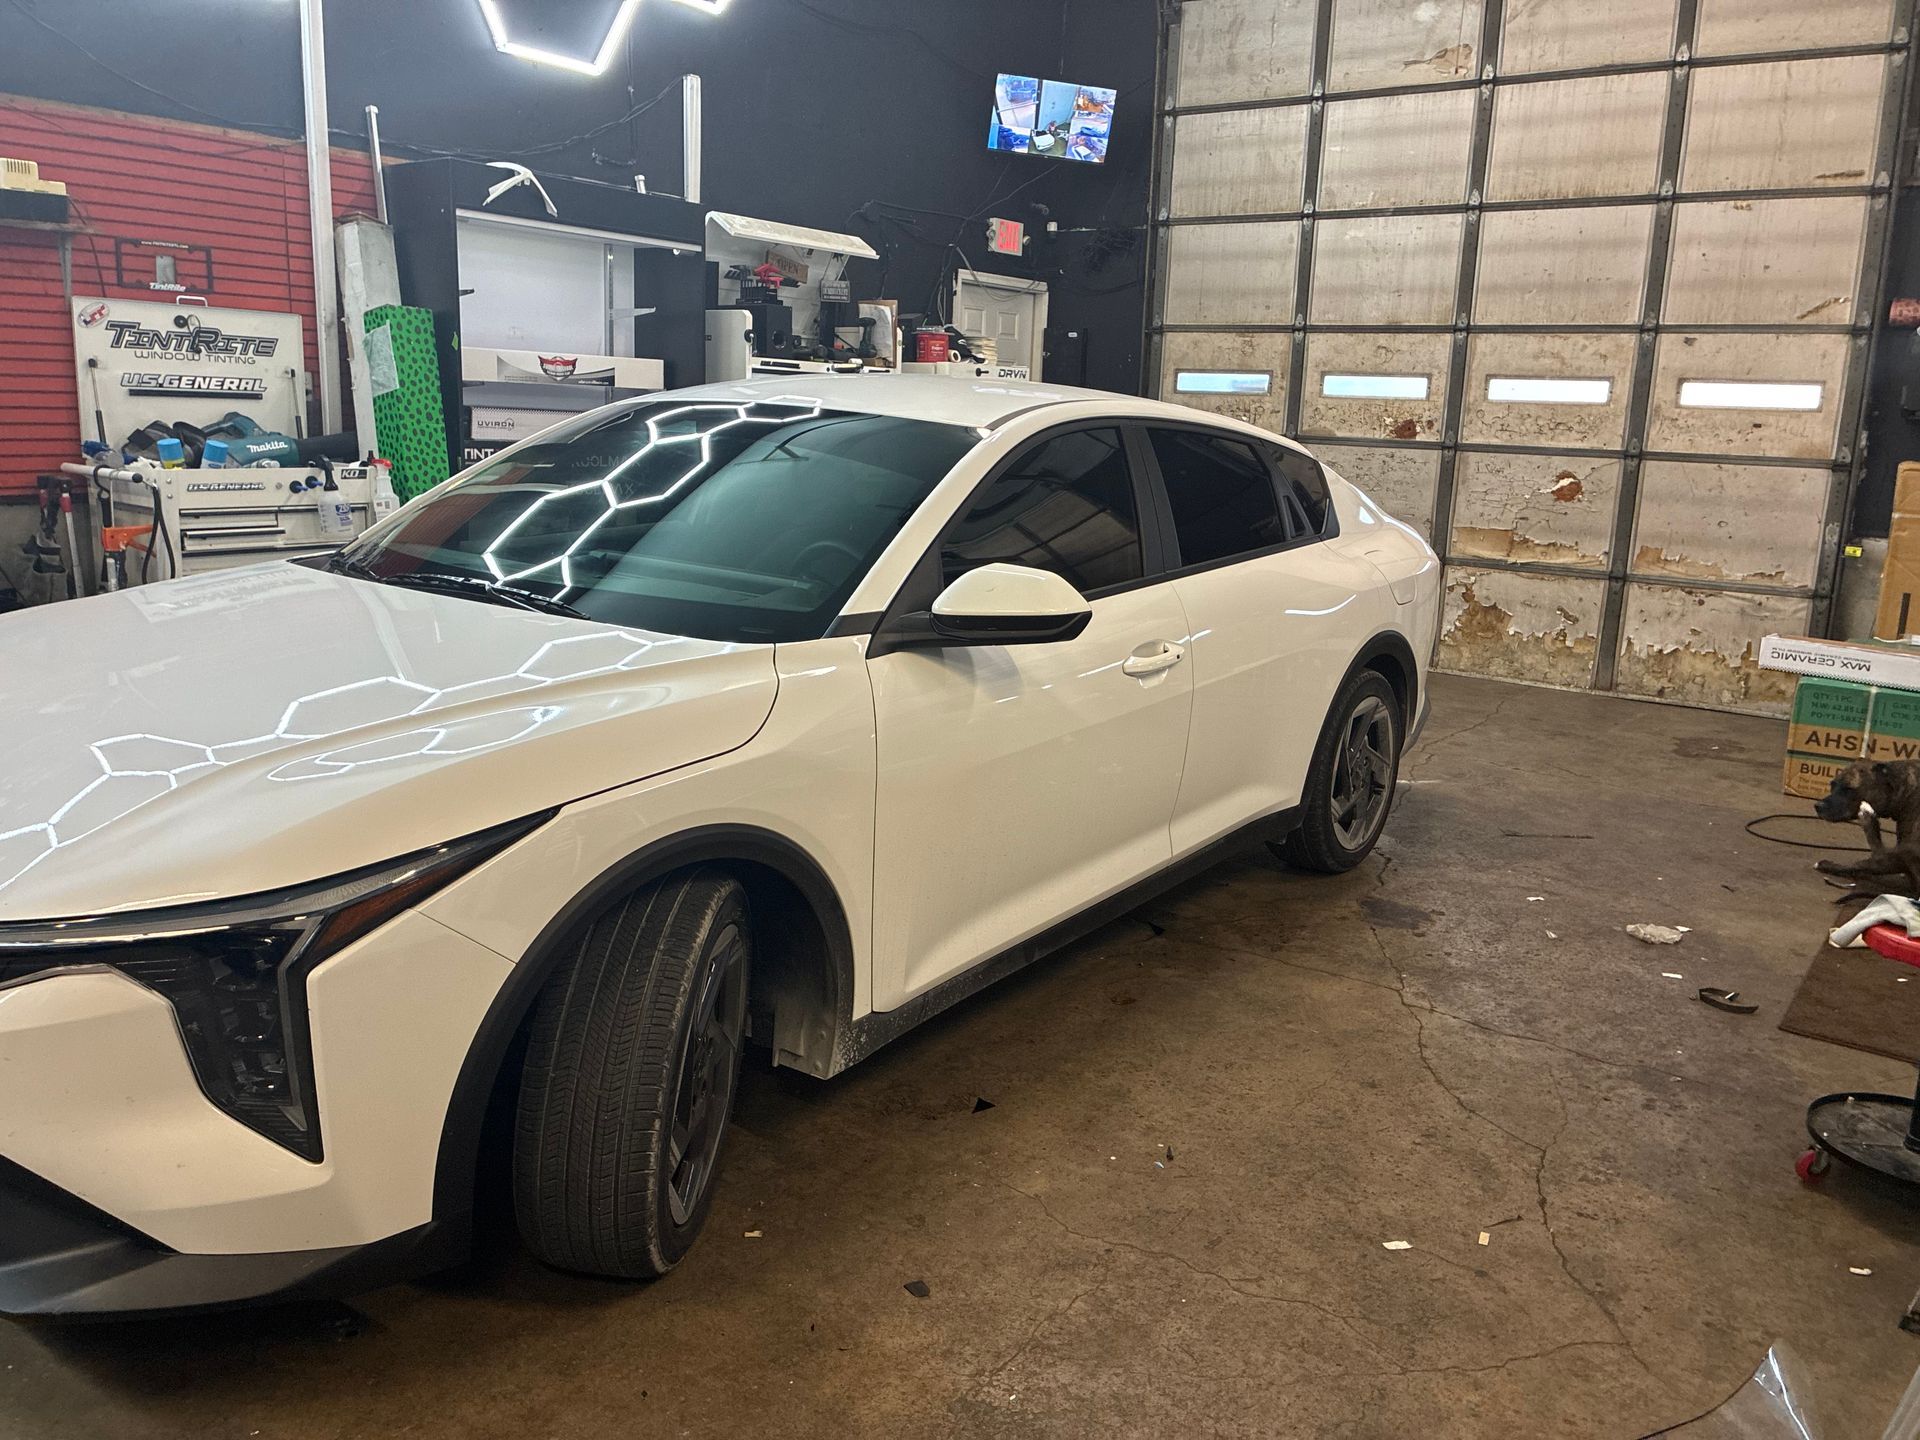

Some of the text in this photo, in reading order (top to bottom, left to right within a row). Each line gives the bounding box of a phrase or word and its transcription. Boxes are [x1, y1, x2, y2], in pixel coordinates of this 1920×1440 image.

[998, 220, 1020, 253] EXIT
[150, 282, 186, 292] TintRite
[134, 350, 256, 365] WINDOW TINTING
[1771, 651, 1871, 671] MAX CERAMIC
[1804, 731, 1920, 759] AHSN-W
